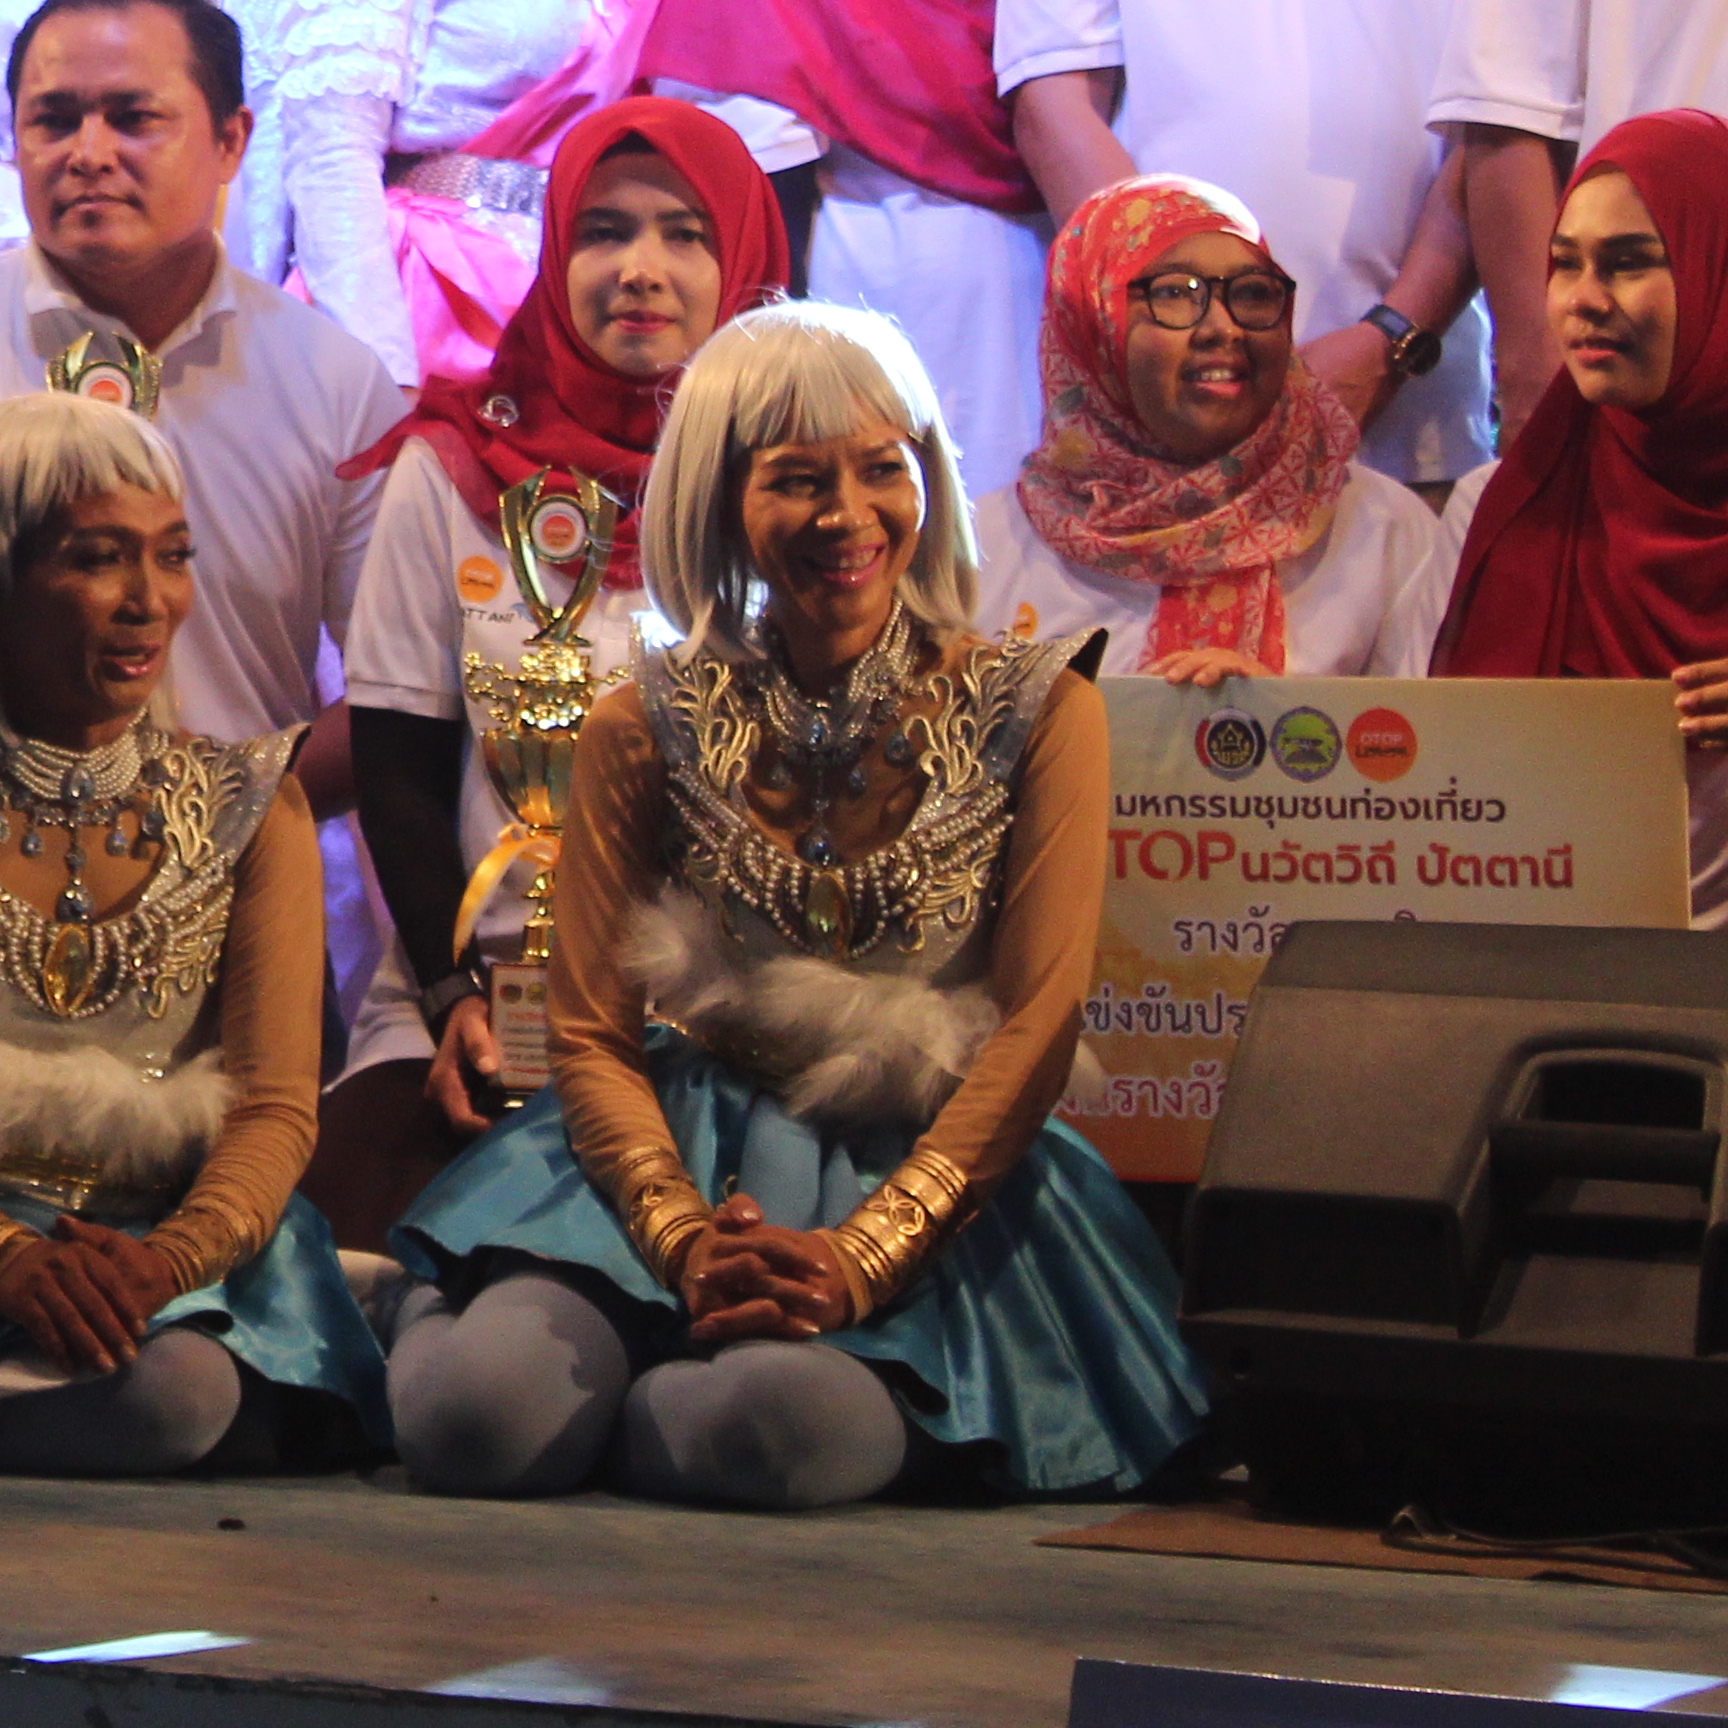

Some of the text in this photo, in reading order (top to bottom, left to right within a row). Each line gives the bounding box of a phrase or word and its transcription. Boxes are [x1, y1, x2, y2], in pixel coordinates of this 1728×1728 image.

[1115, 778, 1506, 829] มหกรรมชุมชนท่องเที่ยว
[1108, 828, 1574, 890] TOP นวัตวิถี ปัตตานี
[1174, 905, 1290, 952] รางวัล
